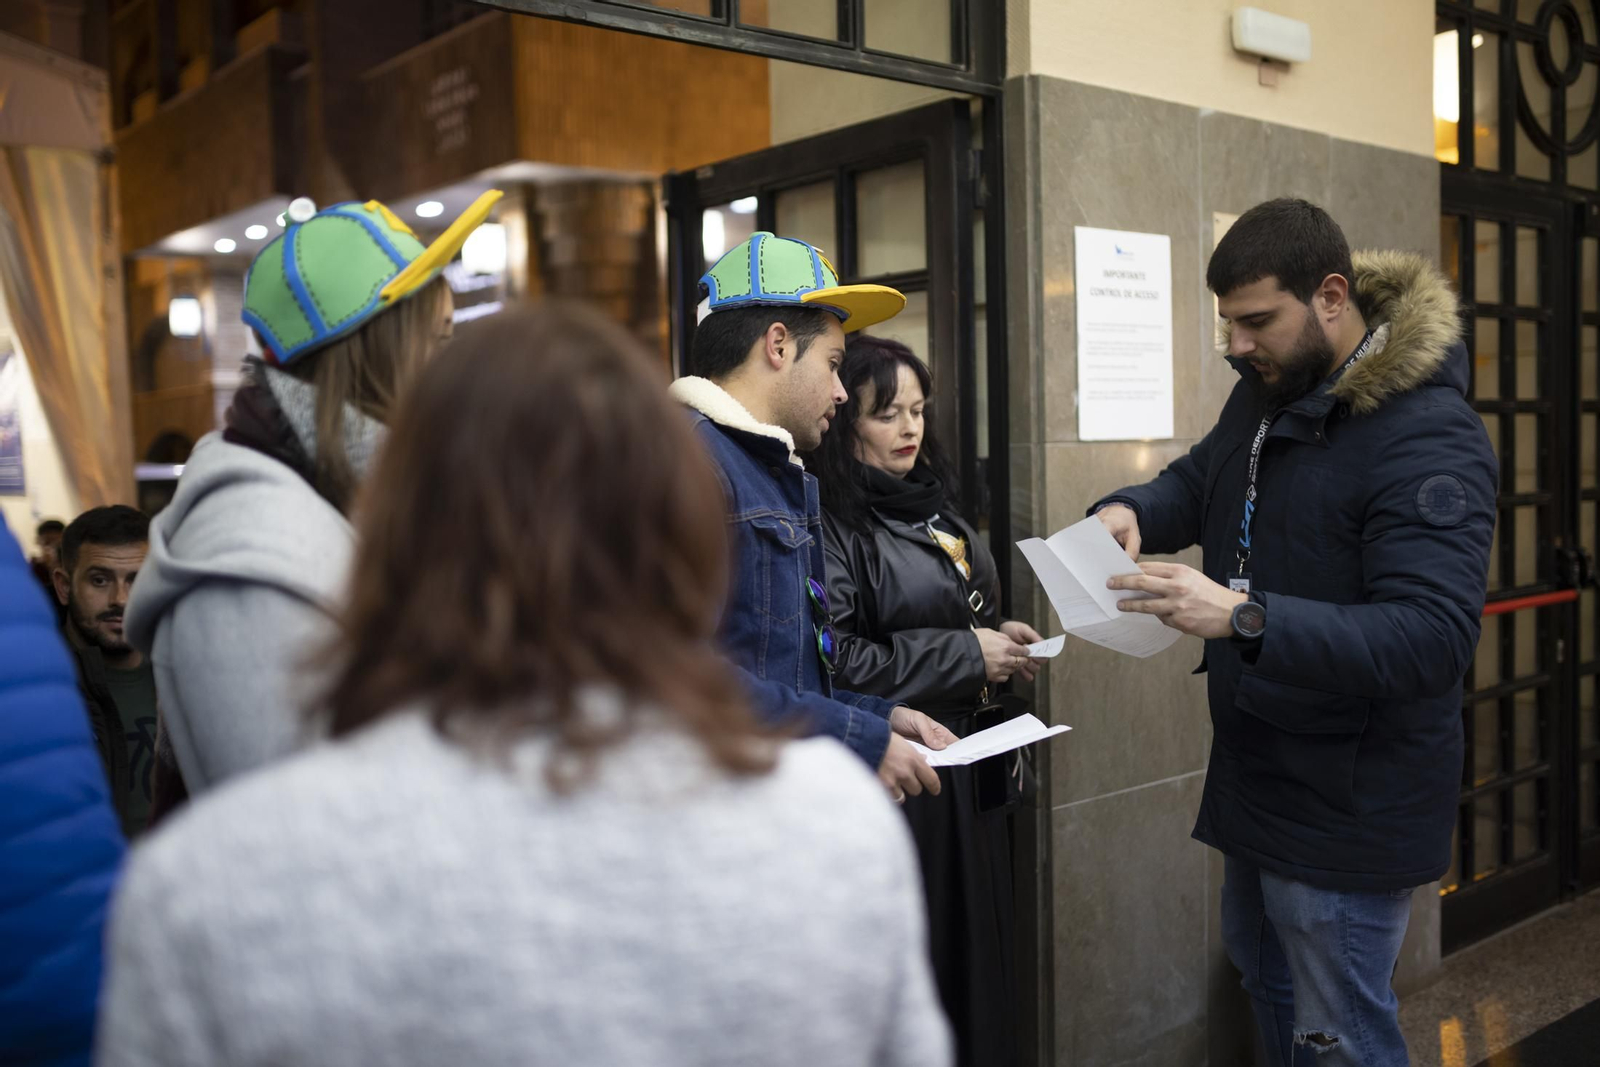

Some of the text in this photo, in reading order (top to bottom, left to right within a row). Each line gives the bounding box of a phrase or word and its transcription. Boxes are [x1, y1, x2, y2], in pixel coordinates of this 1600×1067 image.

[1103, 270, 1146, 281] IMPORTANTE
[1089, 287, 1160, 300] CONTROL DE ACCESO
